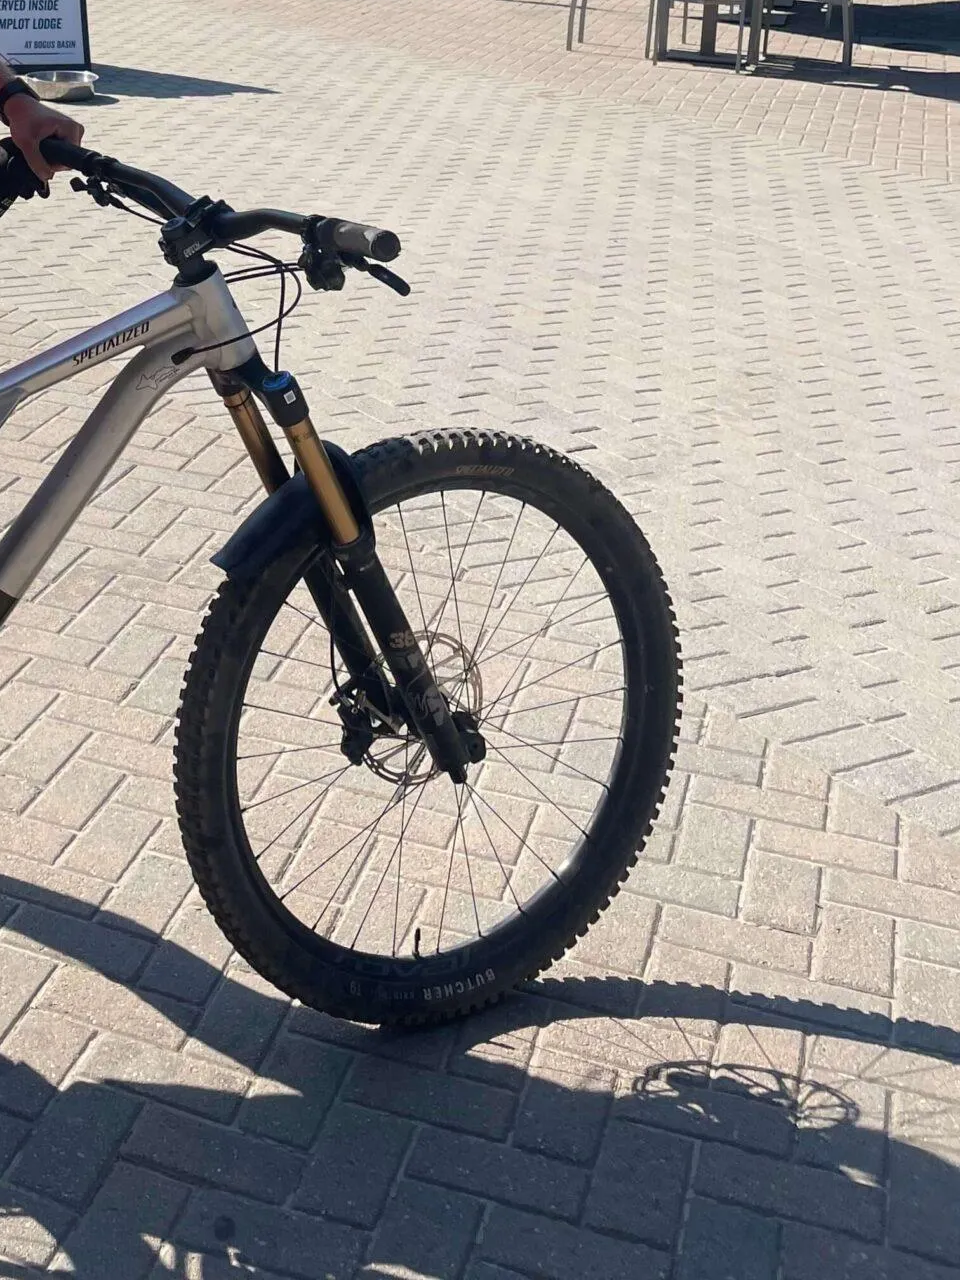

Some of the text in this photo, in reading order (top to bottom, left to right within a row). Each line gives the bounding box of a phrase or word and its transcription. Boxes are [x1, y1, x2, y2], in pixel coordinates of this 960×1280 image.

[28, 0, 60, 11] INSIDE
[32, 18, 62, 30] LODGE
[24, 40, 76, 49] AT BOGUS BASIN
[72, 321, 150, 367] SPECIALIZED
[422, 968, 496, 1001] BUTCHER
